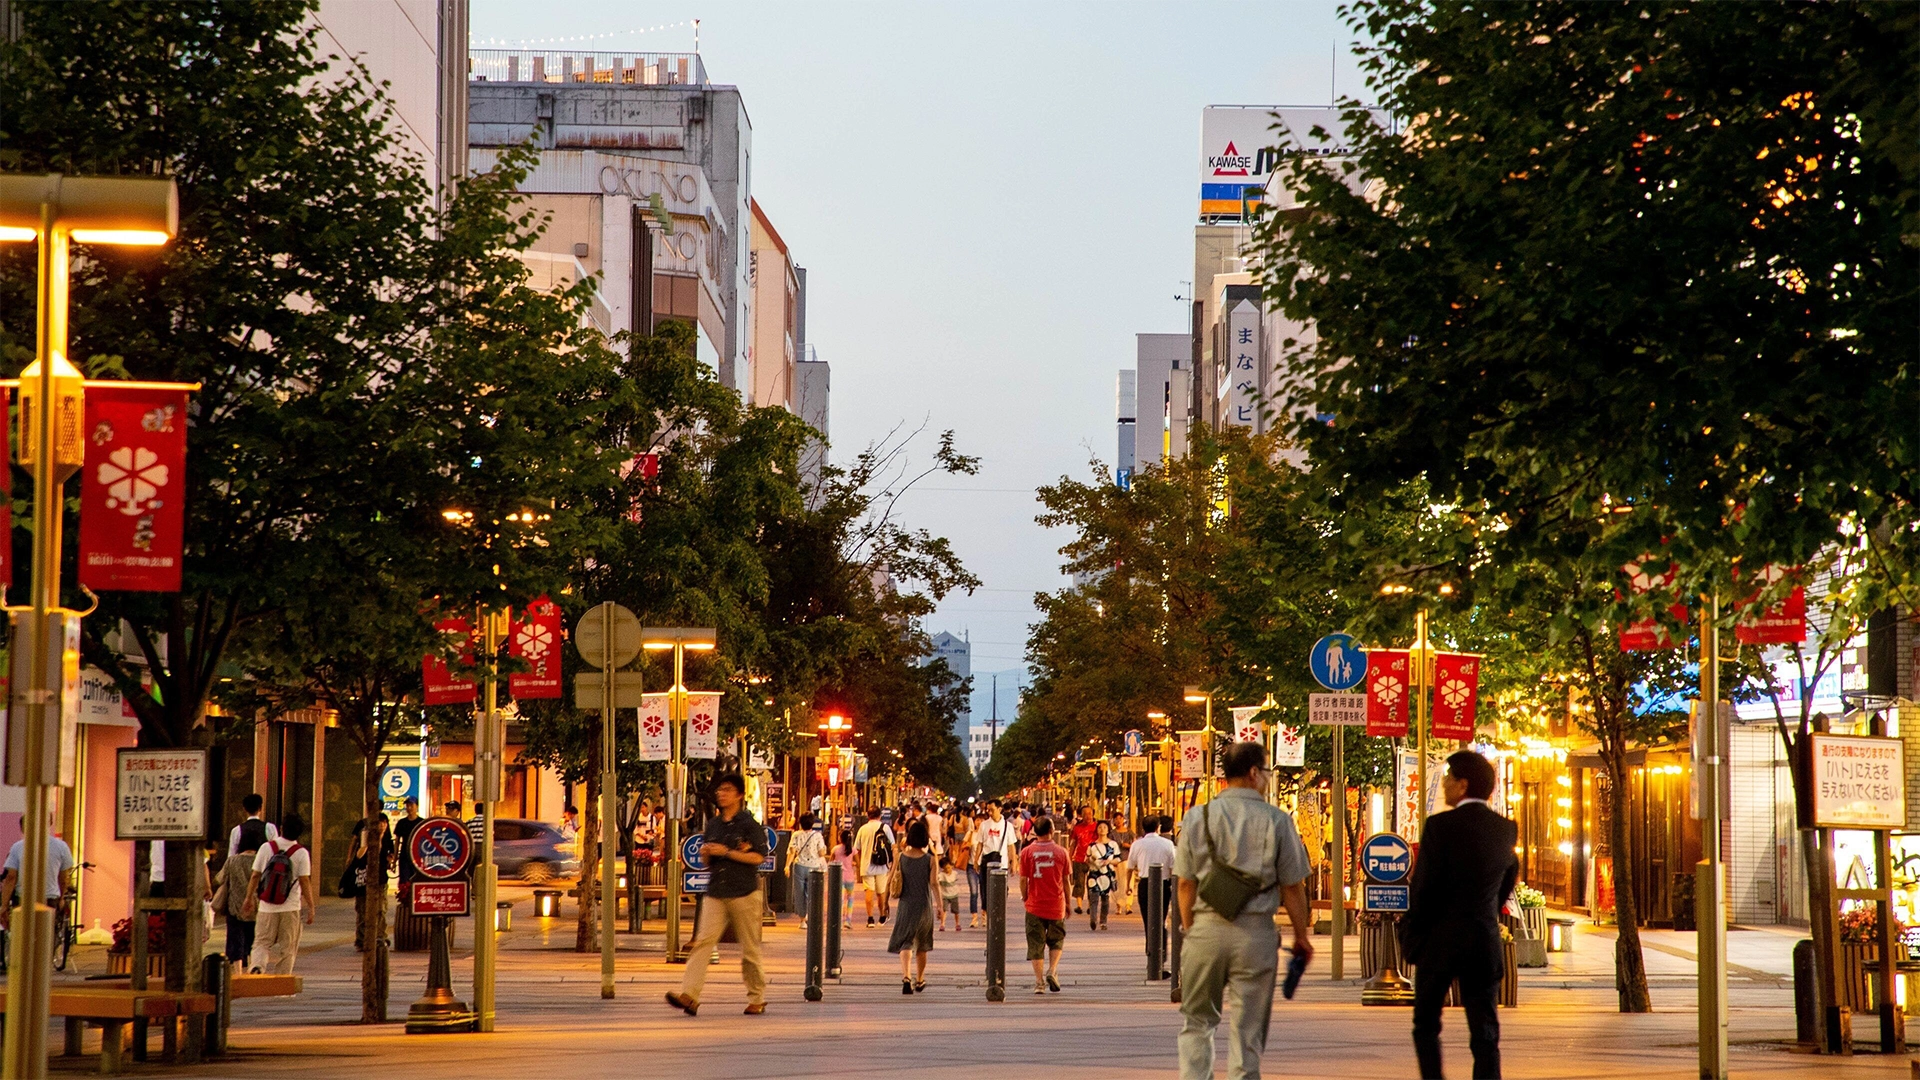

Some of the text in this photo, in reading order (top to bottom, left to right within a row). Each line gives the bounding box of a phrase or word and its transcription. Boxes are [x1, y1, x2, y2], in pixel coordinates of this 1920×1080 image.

[1209, 156, 1251, 168] KAWASE
[599, 165, 697, 203] OKUNO
[1315, 697, 1364, 708] 歩行者用道路
[1827, 761, 1889, 780] 「ハト」にえさを
[390, 775, 403, 789] 5
[1822, 781, 1899, 801] 与えないでください
